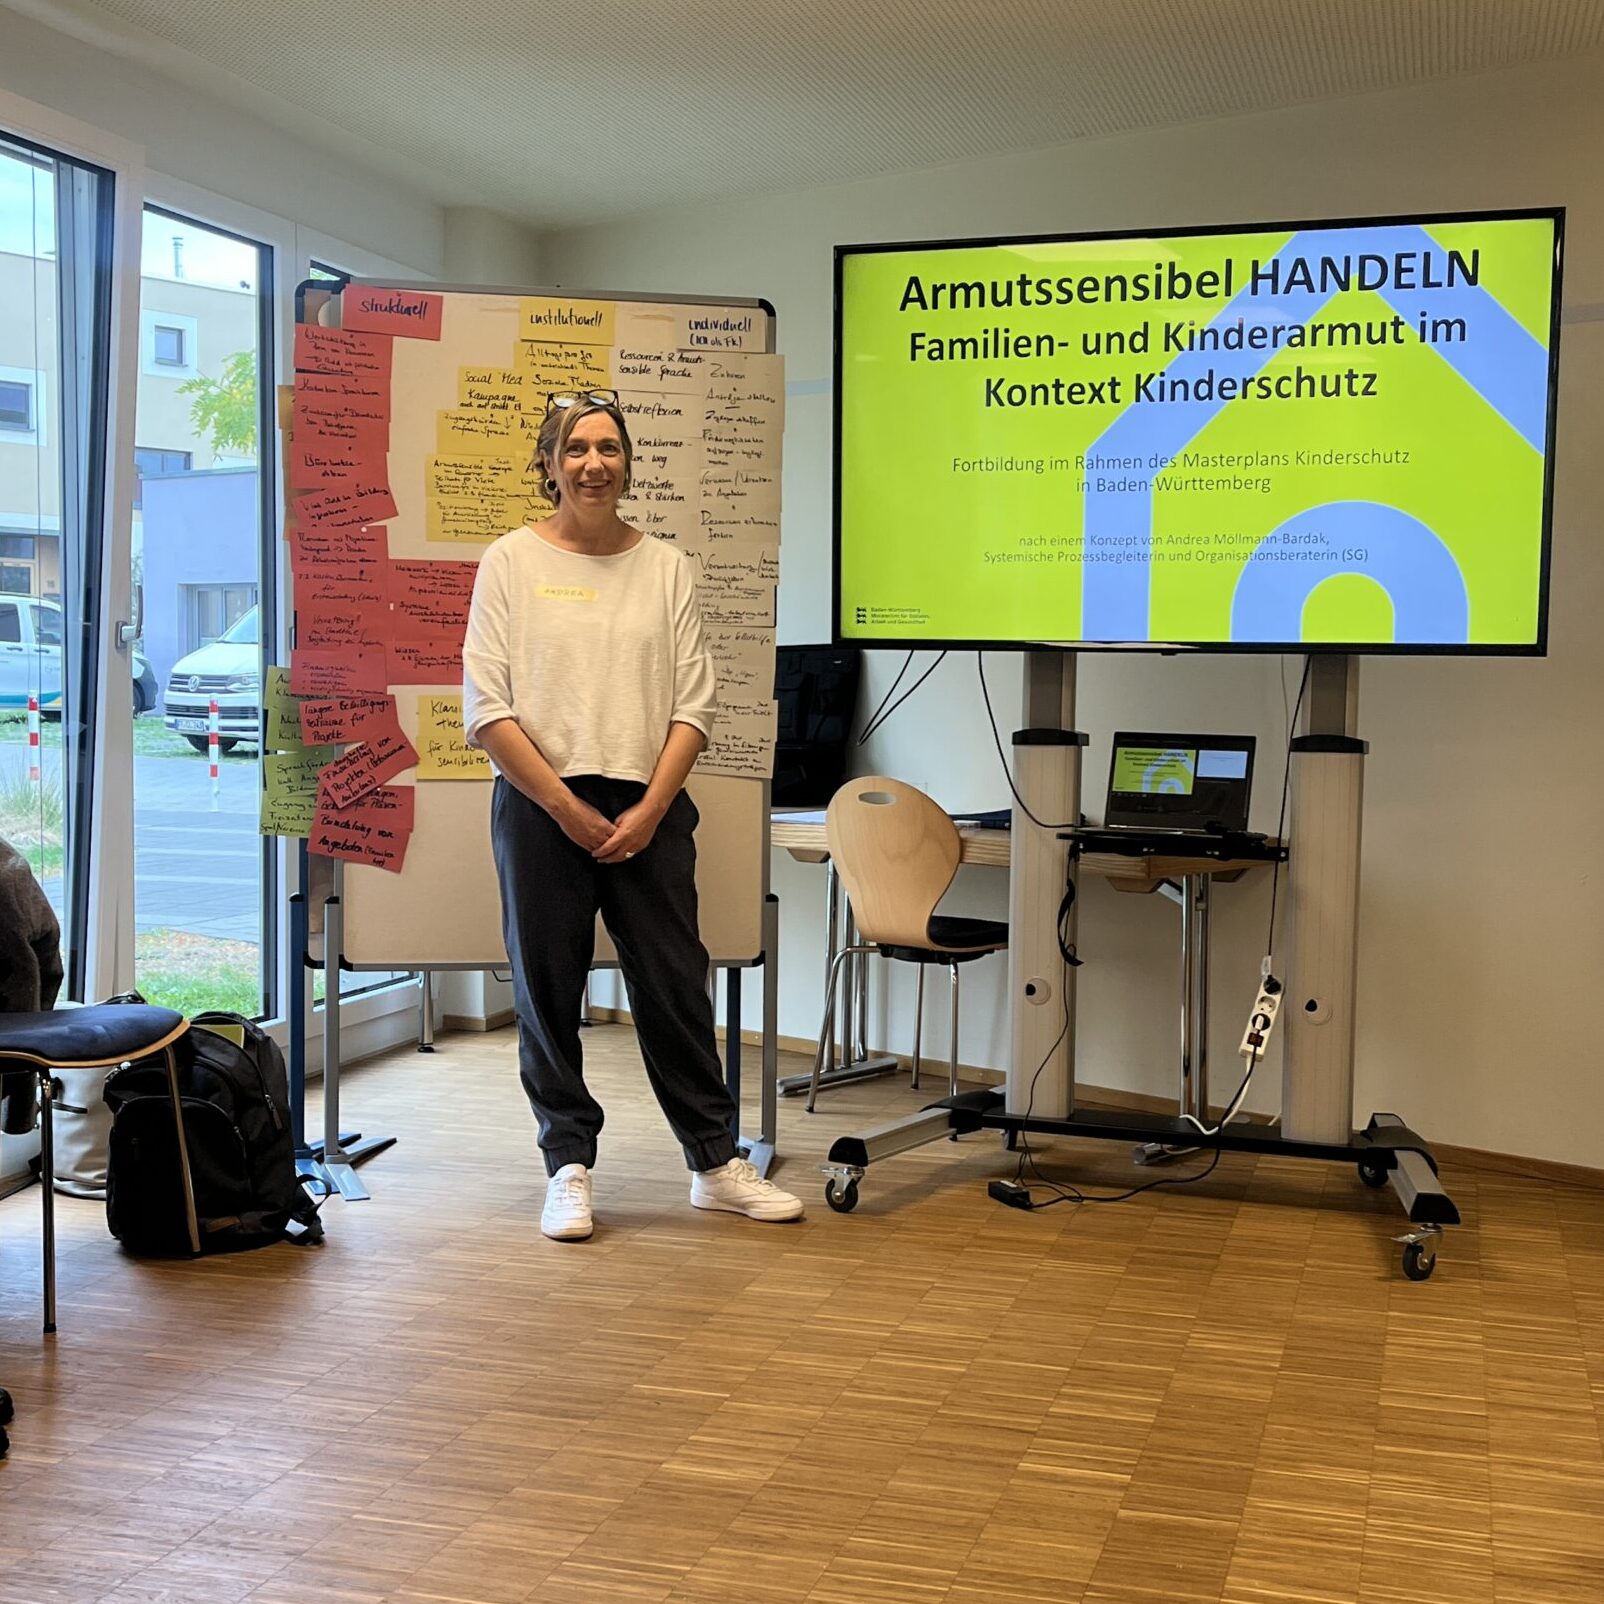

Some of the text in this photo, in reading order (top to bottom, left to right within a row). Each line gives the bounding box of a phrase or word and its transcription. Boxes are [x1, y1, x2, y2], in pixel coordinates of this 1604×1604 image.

[899, 249, 1480, 311] Armutssensibel HANDELN
[910, 311, 1467, 361] Familien- und Kinderarmut im
[985, 366, 1378, 407] Kontext Kinderschutz
[953, 449, 1410, 474] Fortbildung im Rahmen des Masterplans Kinderschutz
[1076, 475, 1271, 493] in Baden-Württemberg
[1019, 535, 1047, 547] nach
[1050, 536, 1085, 546] einem
[1090, 534, 1137, 548] Konzept
[1141, 537, 1162, 546] von
[1166, 534, 1210, 546] Andrea
[984, 548, 1369, 564] Systemische Prozessbegleiterin und Organisationsberaterin (SG)
